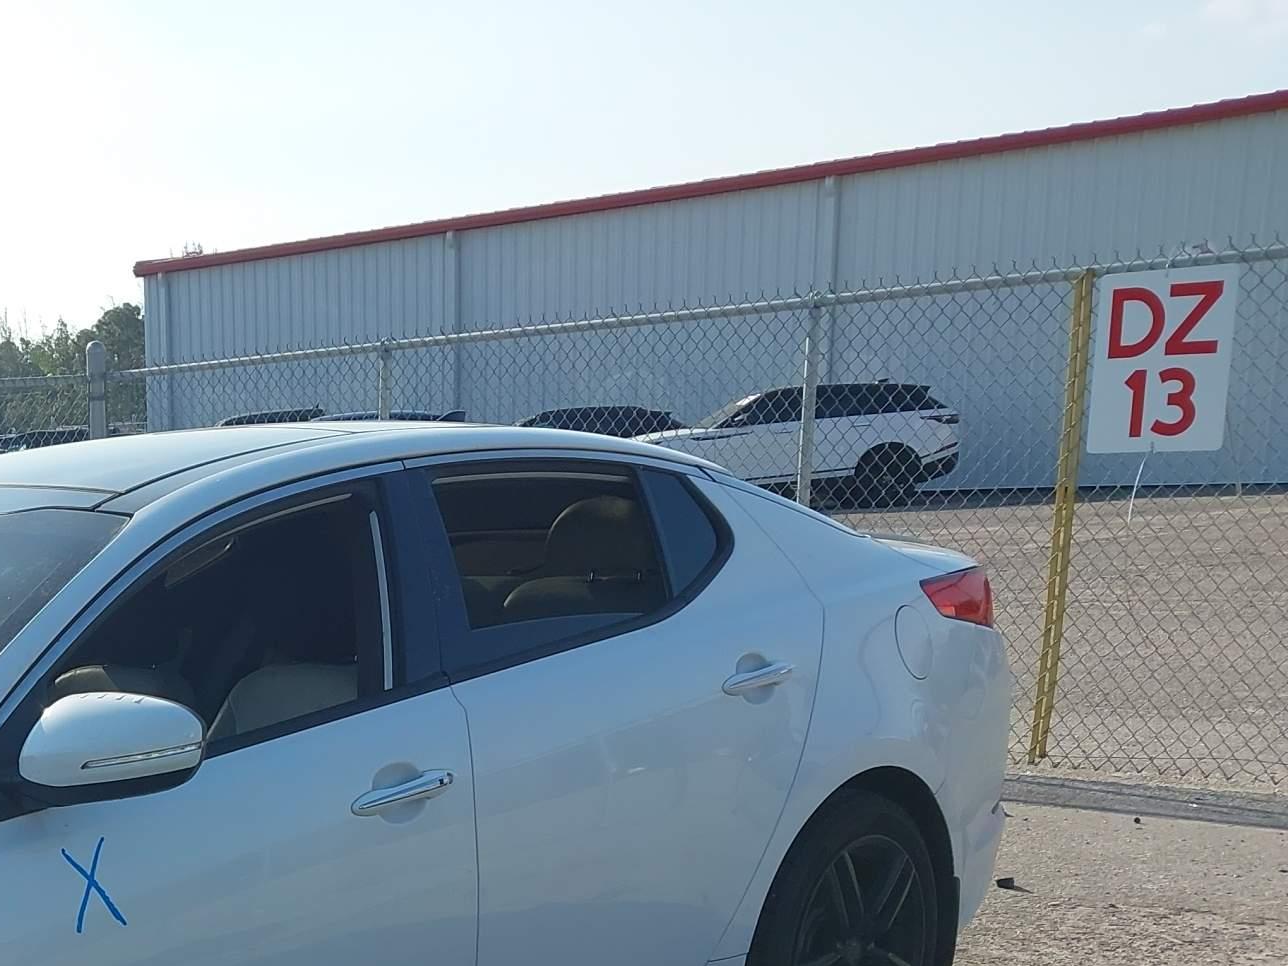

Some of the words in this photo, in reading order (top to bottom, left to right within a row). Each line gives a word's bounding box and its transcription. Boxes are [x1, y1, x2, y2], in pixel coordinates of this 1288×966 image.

[1108, 281, 1223, 359] DZ
[1125, 368, 1196, 438] 13
[61, 836, 127, 933] X
